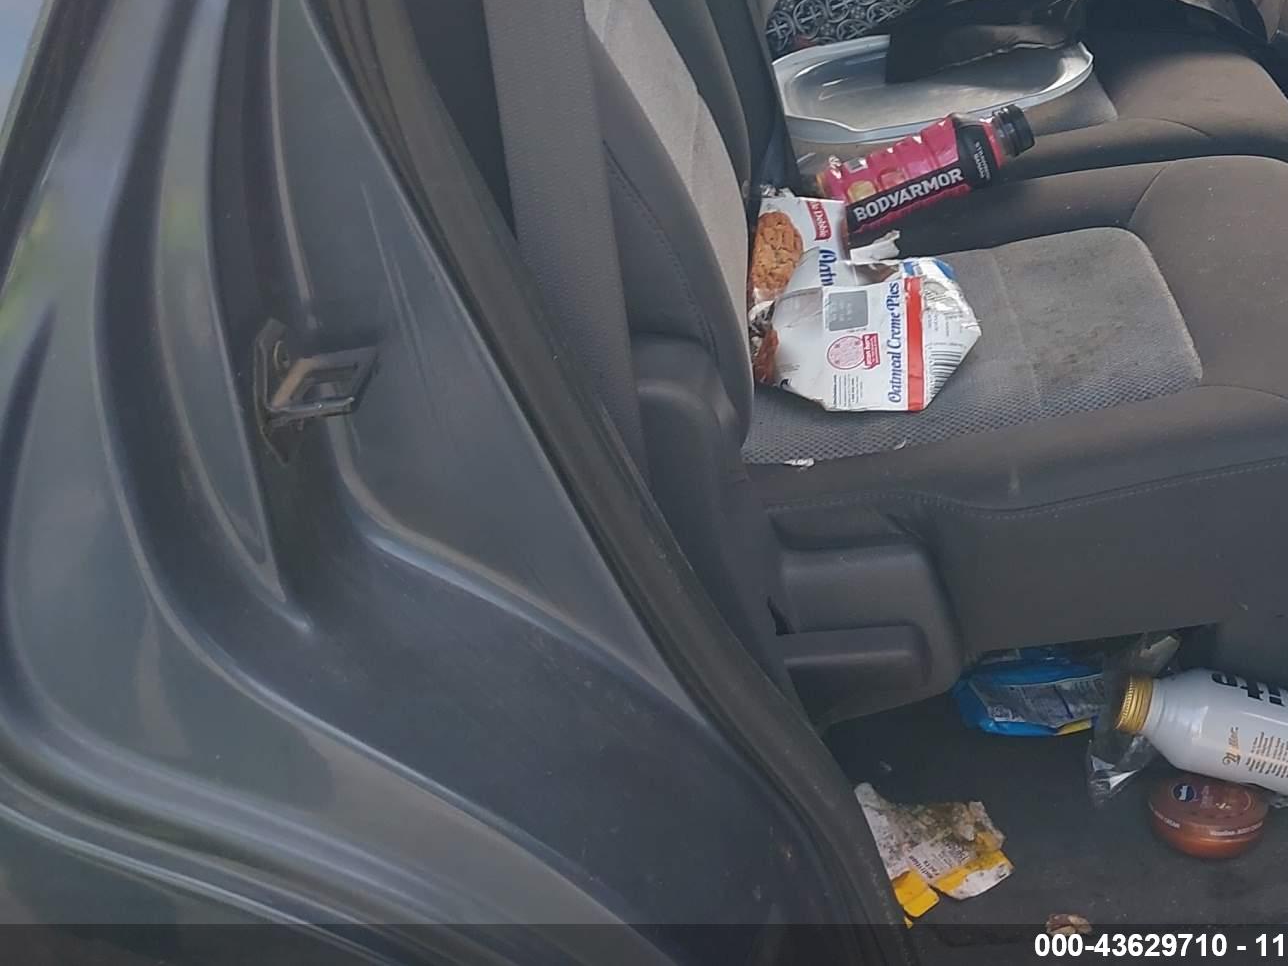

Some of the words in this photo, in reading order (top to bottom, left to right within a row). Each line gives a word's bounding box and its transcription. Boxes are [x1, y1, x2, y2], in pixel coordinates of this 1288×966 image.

[853, 168, 963, 222] BODYARMOR
[886, 282, 900, 311] Pies
[887, 312, 902, 349] Creme
[887, 351, 902, 403] Oatmeal
